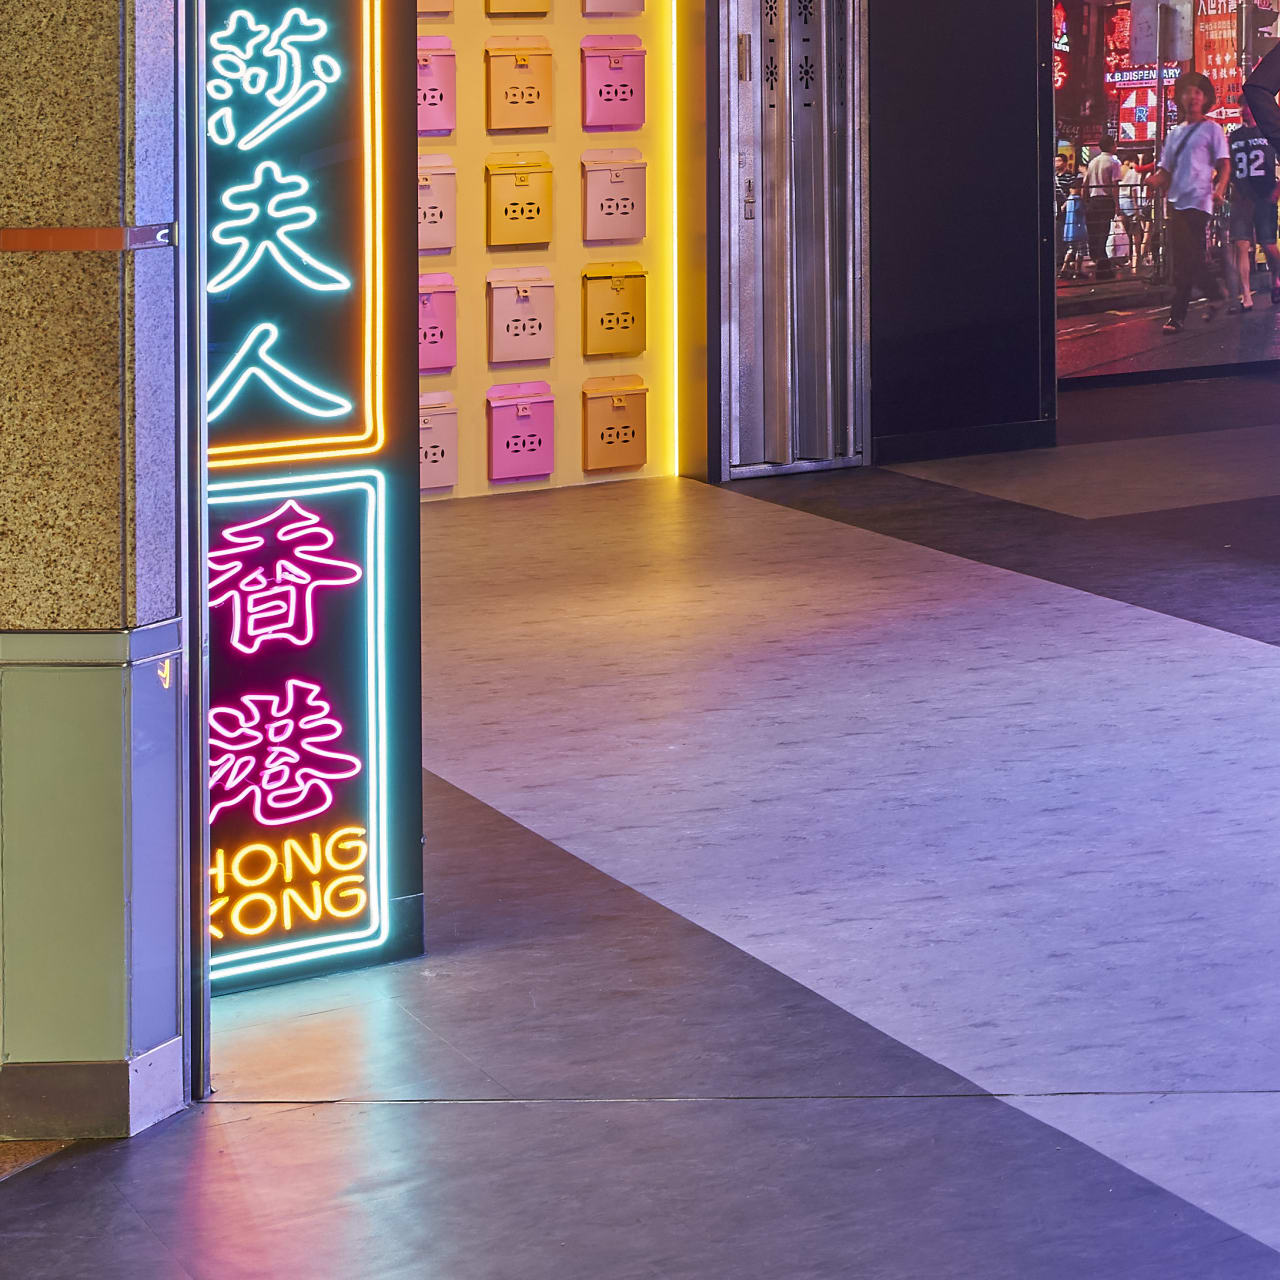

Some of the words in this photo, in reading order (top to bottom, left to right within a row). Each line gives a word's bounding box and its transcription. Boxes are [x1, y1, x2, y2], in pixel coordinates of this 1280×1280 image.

[1106, 69, 1181, 83] K.B.DISPENARY
[1235, 150, 1266, 180] 32
[207, 499, 363, 826] 香港
